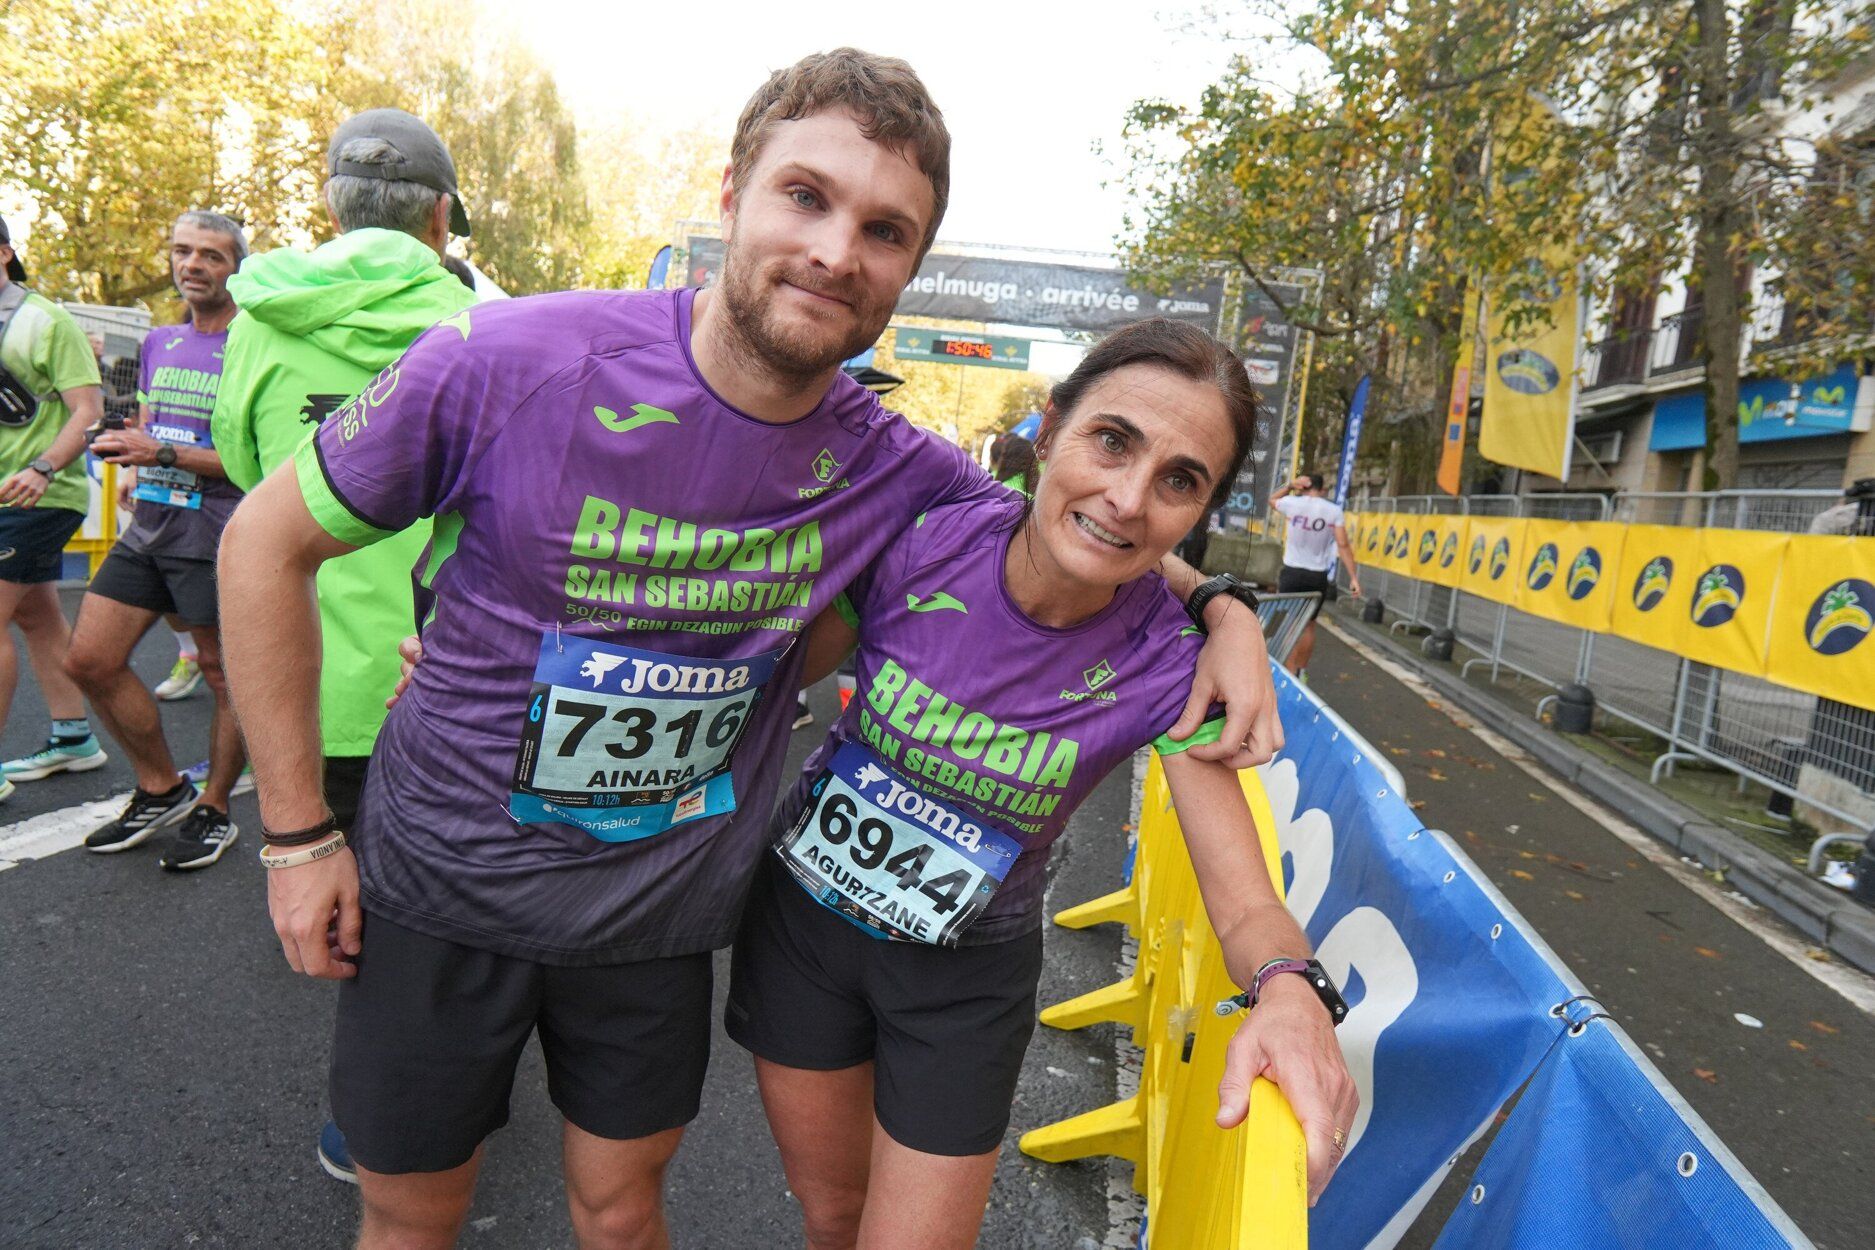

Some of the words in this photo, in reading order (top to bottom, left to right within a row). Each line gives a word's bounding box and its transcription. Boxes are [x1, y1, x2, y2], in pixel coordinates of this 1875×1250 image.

[1041, 284, 1140, 312] arrivée
[798, 478, 850, 498] FORNA
[570, 495, 823, 573] BEHOBIA
[1292, 514, 1327, 532] FLO
[564, 564, 638, 605] SAN
[645, 575, 814, 612] SEBASTIÁN
[566, 603, 622, 623] 50/50
[627, 617, 668, 631] EGIN
[671, 618, 743, 635] DEZAGUN
[744, 617, 804, 632] POSIBLE
[529, 694, 543, 723] 6
[554, 699, 747, 759] 7316
[866, 658, 1079, 788] BEHOBIA
[859, 708, 901, 761] SAN
[903, 748, 1062, 817] SEBASTIÁN
[586, 764, 695, 788] AINARA
[812, 778, 826, 797] 6
[592, 793, 620, 806] 10:12h
[987, 810, 1045, 833] POSIBLE
[819, 793, 972, 916] 6944
